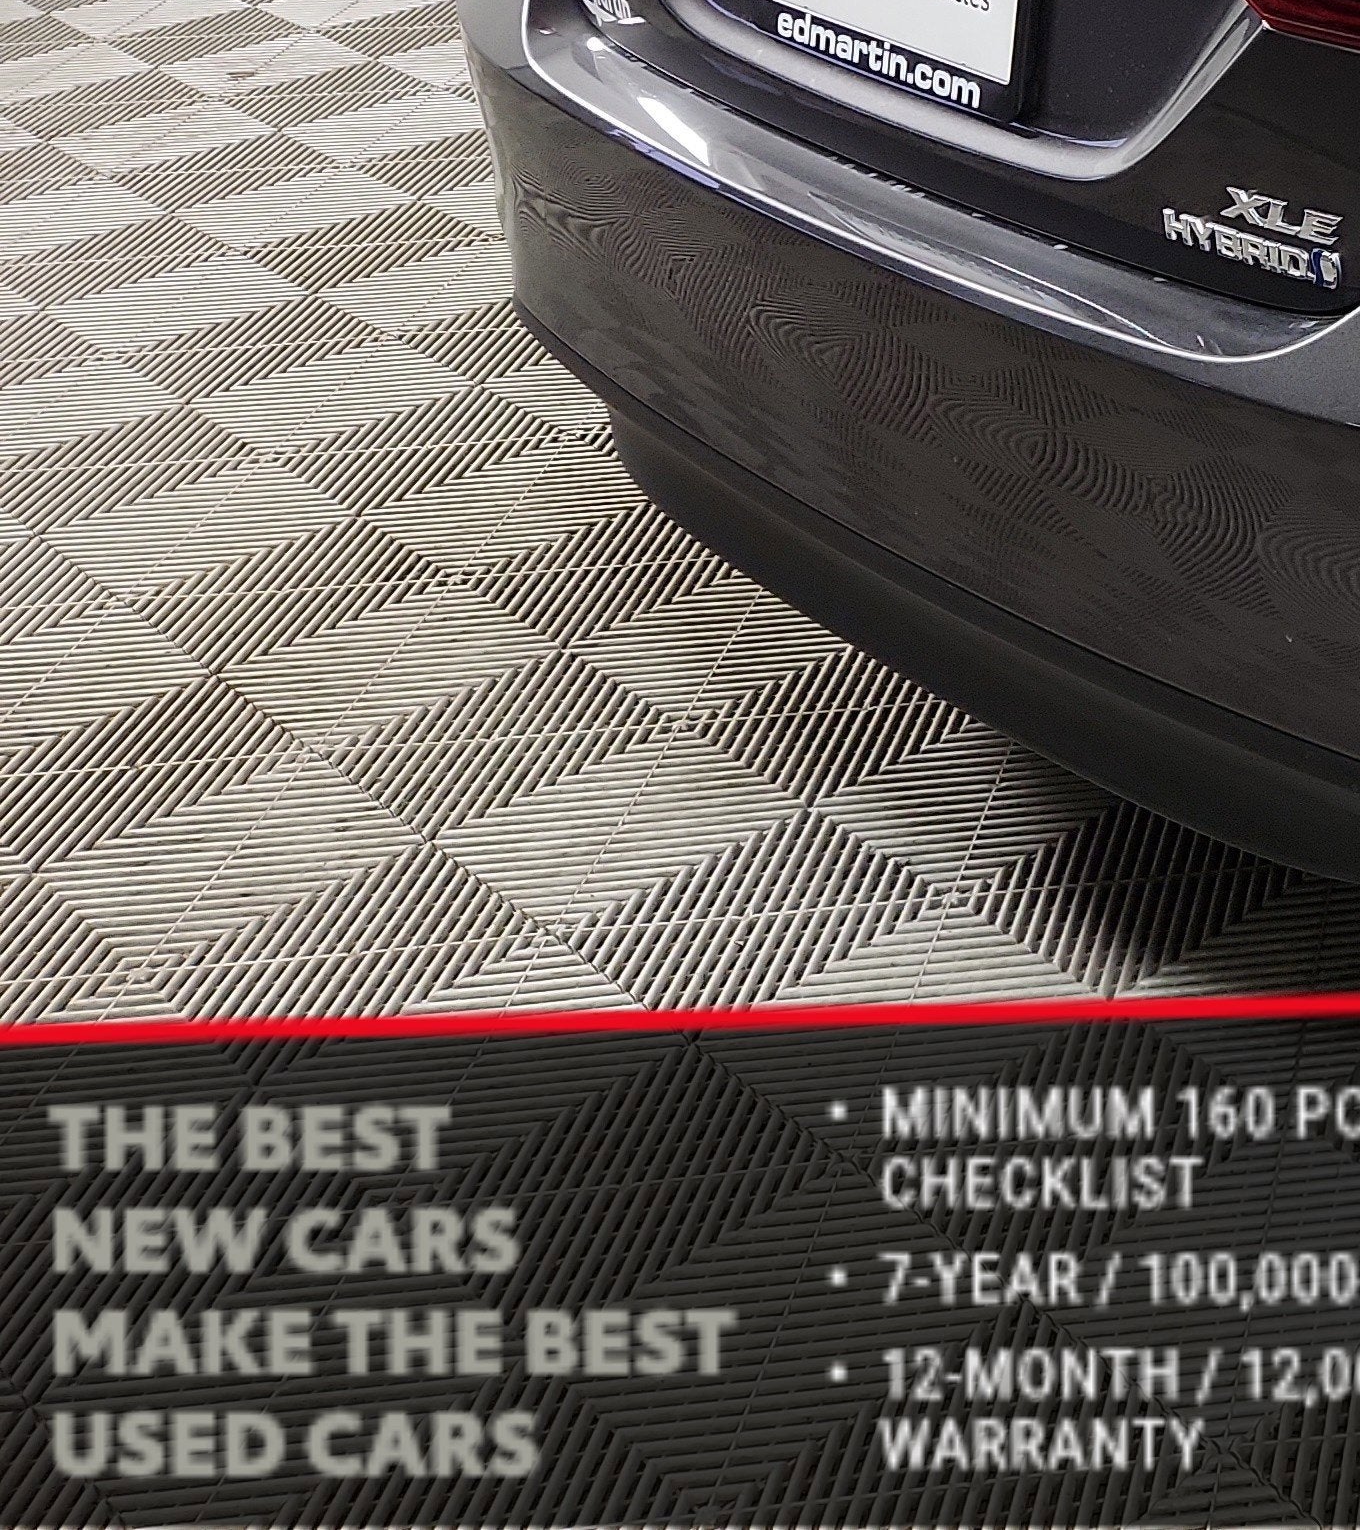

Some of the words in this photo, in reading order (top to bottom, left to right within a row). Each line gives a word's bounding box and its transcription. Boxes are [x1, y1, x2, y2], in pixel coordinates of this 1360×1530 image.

[777, 9, 982, 110] edmartin.com
[1162, 207, 1310, 282] HYBRID
[1220, 186, 1344, 246] XLE
